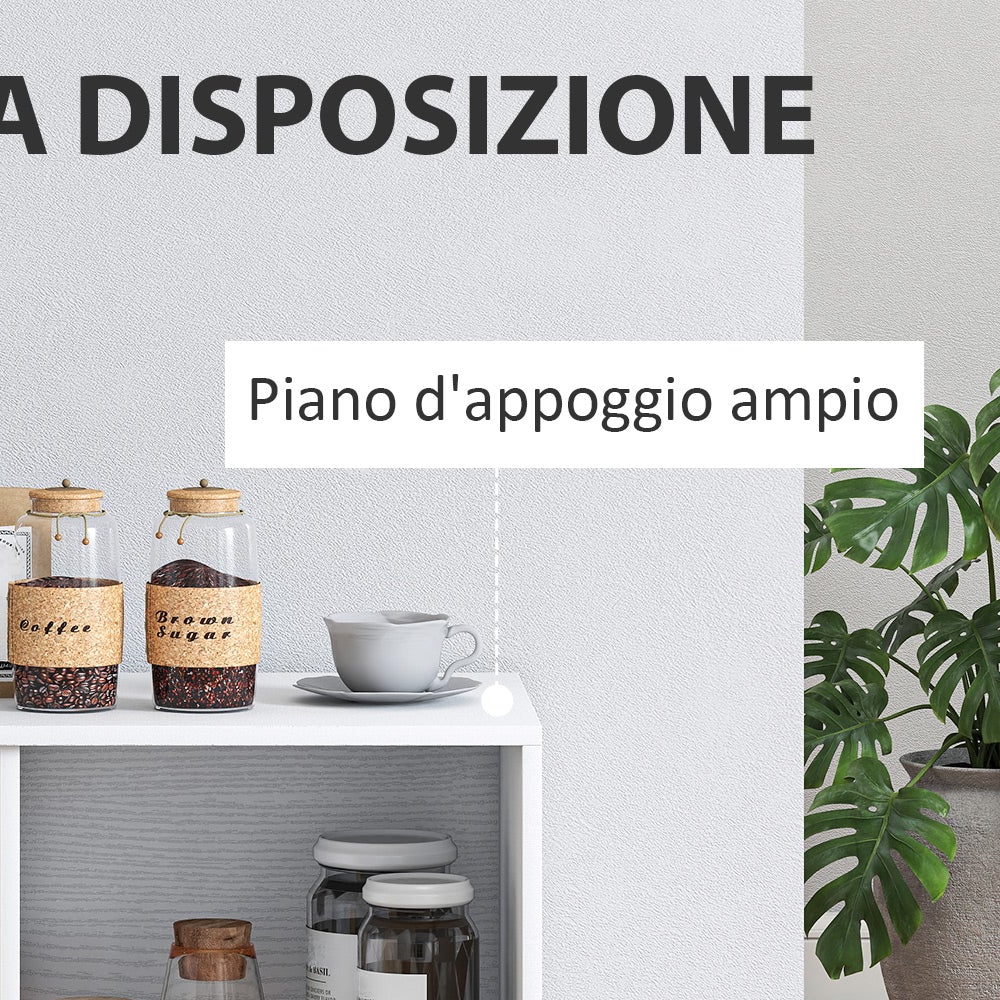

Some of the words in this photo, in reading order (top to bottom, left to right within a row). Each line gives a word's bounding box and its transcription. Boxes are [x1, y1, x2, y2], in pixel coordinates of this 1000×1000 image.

[155, 610, 234, 625] Brown
[19, 619, 92, 635] Coffee
[156, 625, 231, 643] Sugar
